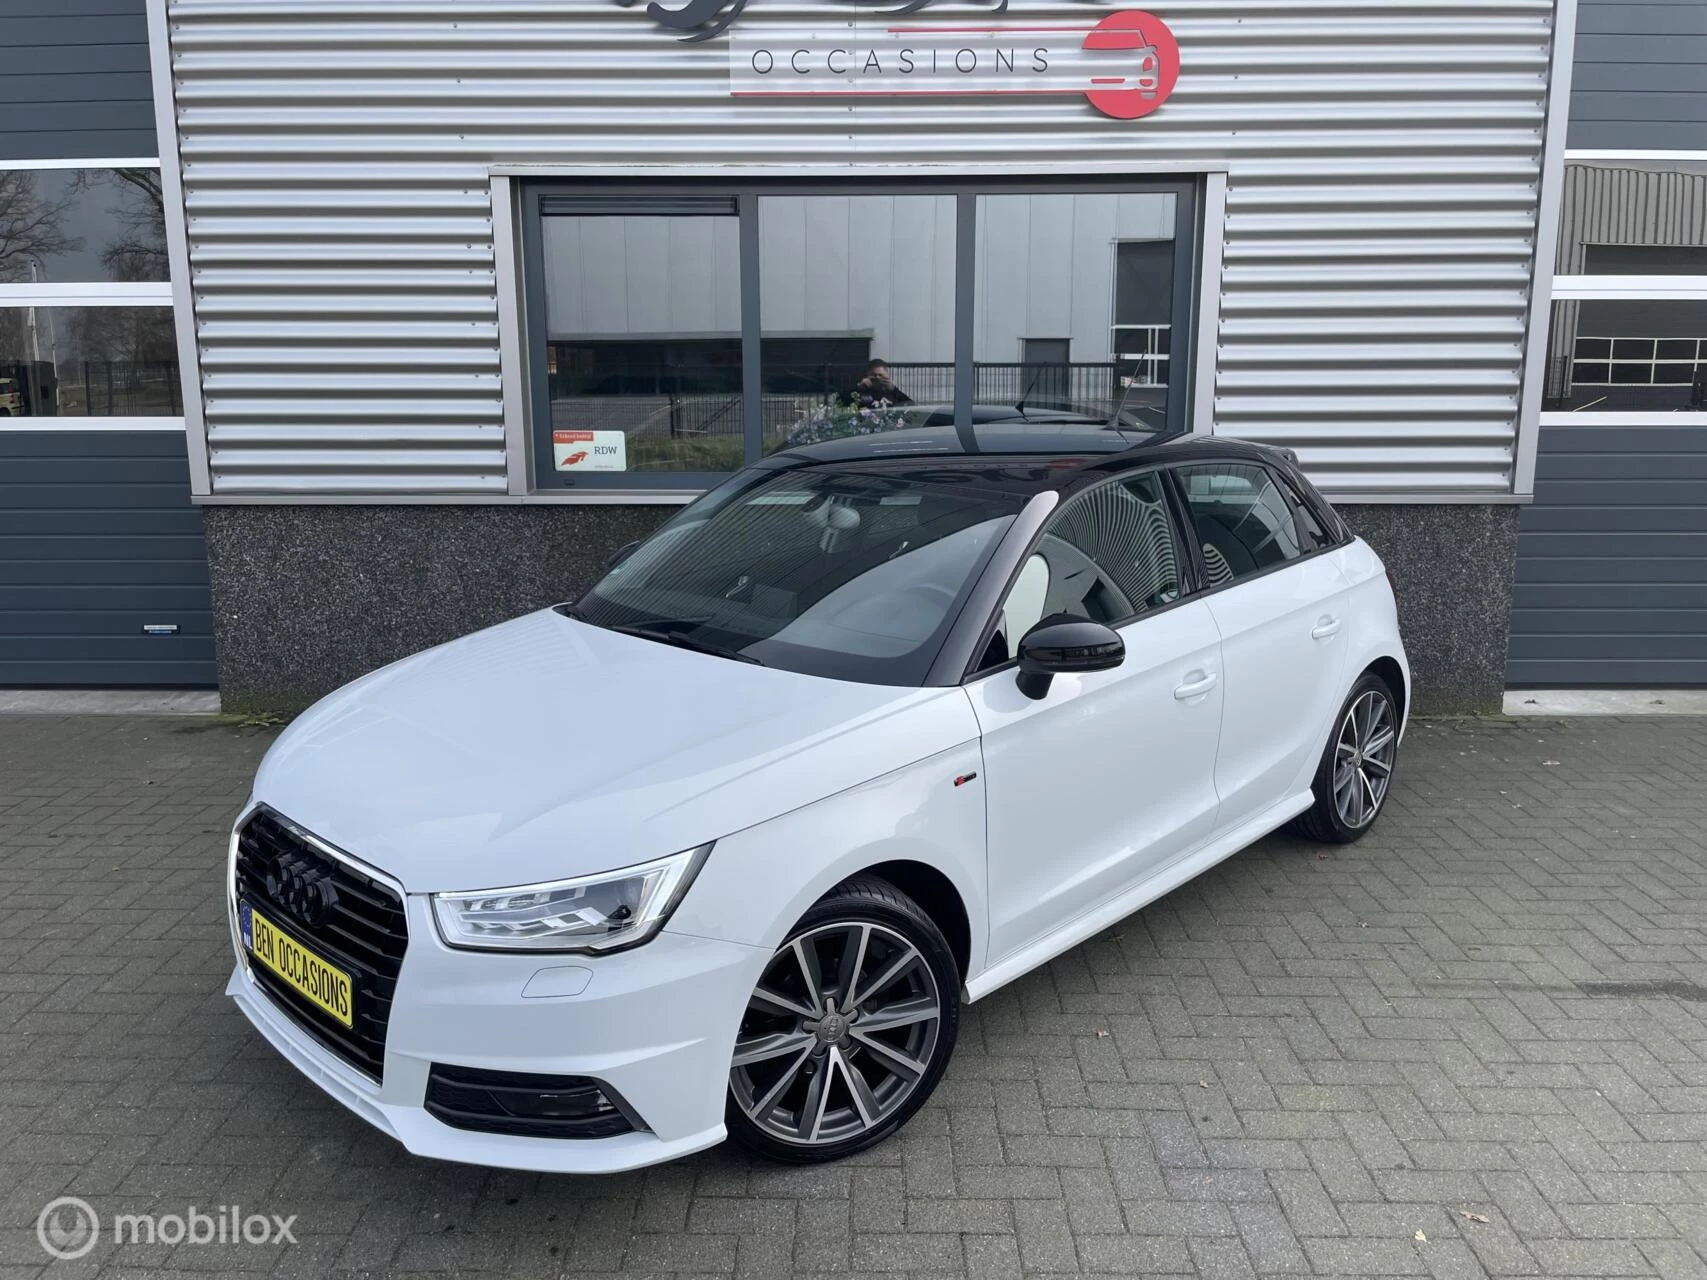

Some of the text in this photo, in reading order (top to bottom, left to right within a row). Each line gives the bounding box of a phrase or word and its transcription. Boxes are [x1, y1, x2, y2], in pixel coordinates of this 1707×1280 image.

[751, 48, 1050, 75] OCCASIONS
[594, 446, 618, 455] RDW
[243, 931, 253, 950] NL
[255, 918, 348, 1017] BEN OCCASIONS
